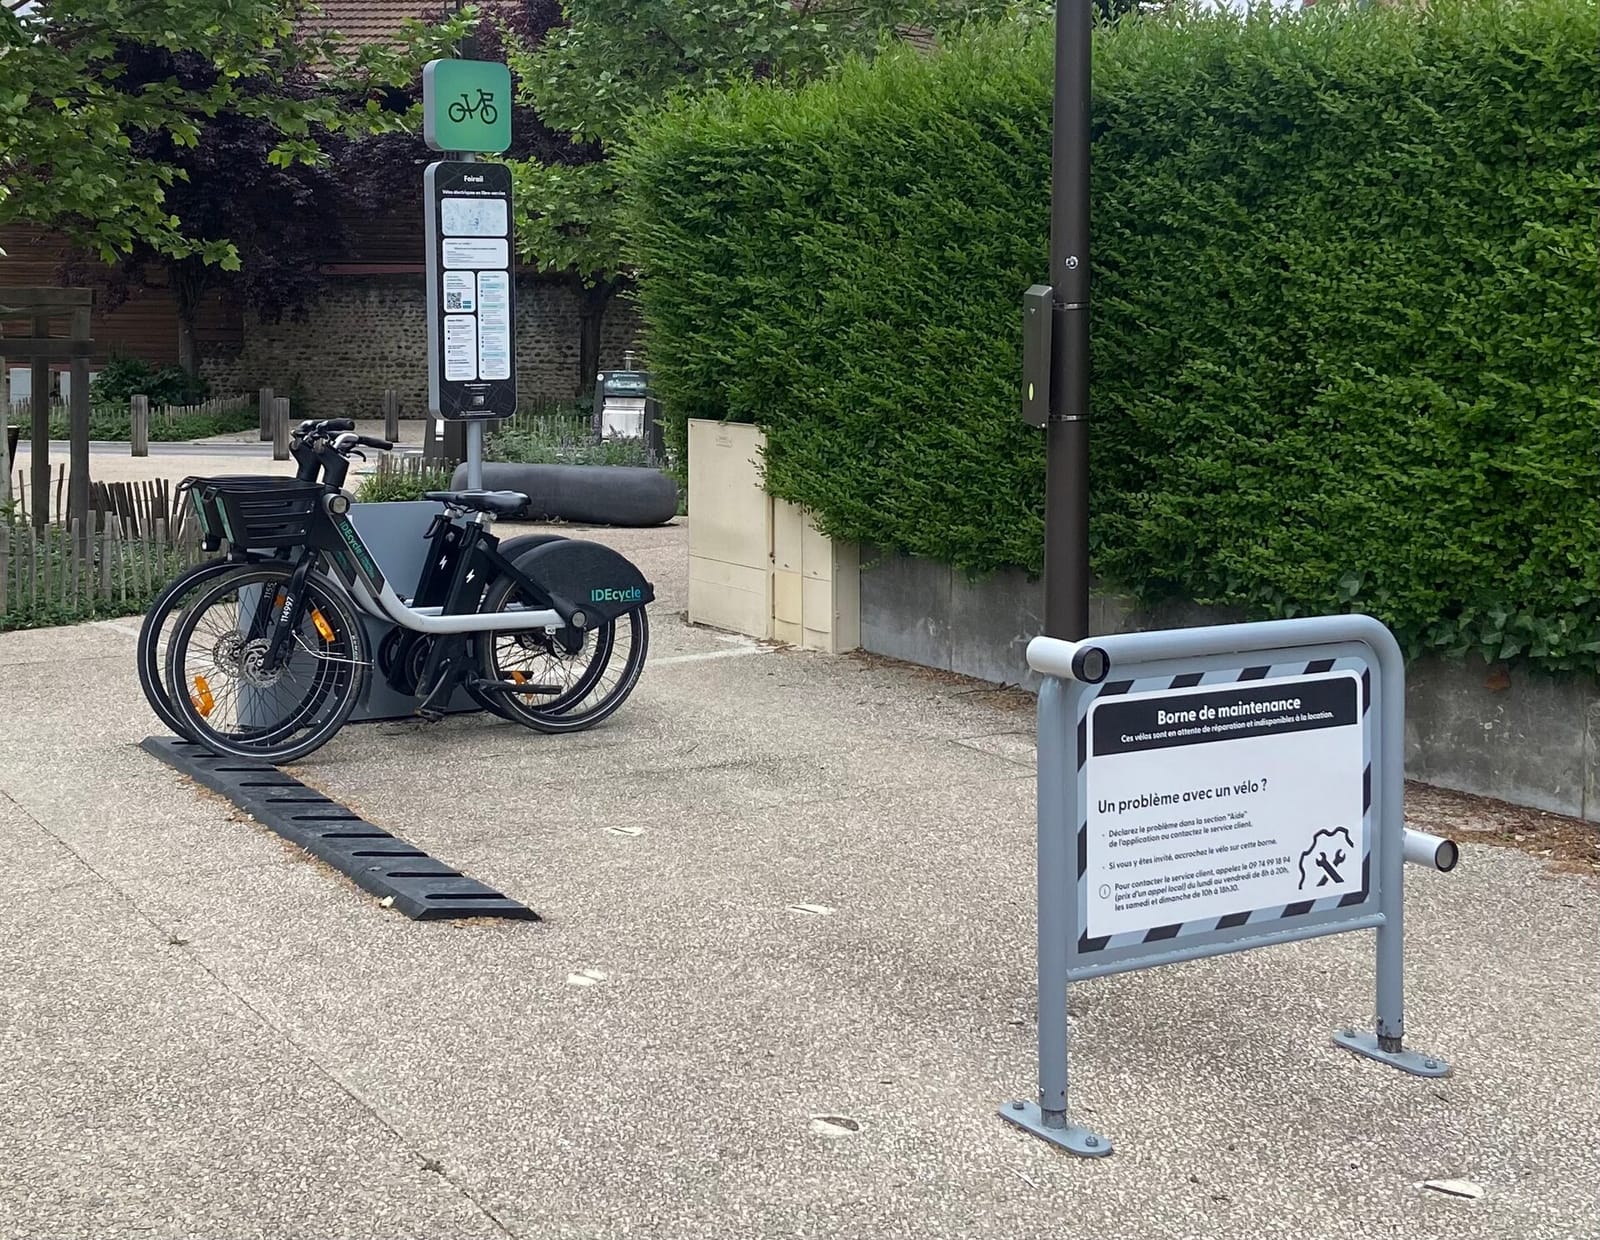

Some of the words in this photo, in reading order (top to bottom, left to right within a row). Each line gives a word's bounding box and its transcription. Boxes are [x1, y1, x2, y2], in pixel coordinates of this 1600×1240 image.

[339, 520, 362, 556] IDEcycle
[280, 596, 294, 622] 114997
[591, 586, 641, 602] IDEcycle
[1157, 710, 1197, 725] Borne
[1199, 705, 1215, 720] de
[1218, 698, 1301, 718] maintenance
[1121, 734, 1134, 743] Ces
[1135, 731, 1152, 741] vélos
[1153, 731, 1167, 739] sont
[1177, 727, 1201, 736] attente
[1202, 725, 1211, 733] de
[1211, 719, 1245, 733] réparation
[1254, 715, 1294, 727] indisponibles
[1301, 713, 1307, 721] la
[1308, 711, 1334, 720] location.
[1098, 800, 1115, 814] Un
[1119, 793, 1180, 815] problème
[1182, 789, 1213, 802] avec
[1216, 786, 1231, 797] un
[1234, 780, 1259, 795] vélo
[1261, 778, 1267, 791] ?
[1109, 828, 1138, 838] Déclarez
[1139, 825, 1145, 833] le
[1146, 822, 1178, 833] problème
[1179, 820, 1195, 828] dans
[1204, 814, 1227, 824] section
[1109, 840, 1118, 848] de
[1119, 834, 1160, 847] l'application
[1170, 829, 1202, 839] contactez
[1203, 826, 1209, 834] le
[1210, 823, 1233, 833] service
[1234, 820, 1252, 829] client.
[1108, 861, 1115, 870] Si
[1116, 860, 1132, 869] vous
[1133, 860, 1138, 868] y
[1138, 857, 1153, 865] êtes
[1153, 853, 1173, 863] invité,
[1174, 848, 1207, 860] accrochez
[1215, 845, 1229, 853] vélo
[1240, 841, 1256, 850] cette
[1257, 838, 1277, 848] borne.
[1115, 883, 1130, 891] Pour
[1131, 878, 1163, 888] contacter
[1171, 872, 1195, 881] service
[1195, 869, 1215, 878] client,
[1215, 864, 1241, 875] appelez
[1248, 861, 1257, 869] 09
[1266, 858, 1274, 866] 99
[1115, 893, 1131, 902] (prix
[1132, 890, 1147, 898] d'un
[1147, 886, 1167, 896] appel
[1168, 882, 1186, 892] local)
[1187, 881, 1196, 889] du
[1196, 878, 1213, 888] lundi
[1223, 872, 1251, 883] vendredi
[1252, 871, 1260, 879] de
[1261, 869, 1269, 877] 8h
[1270, 868, 1275, 876] à
[1115, 903, 1125, 911] les
[1125, 899, 1150, 910] samedi
[1158, 893, 1191, 904] dimanche
[1192, 891, 1201, 899] de
[1201, 888, 1213, 897] 10h
[1213, 887, 1218, 895] à
